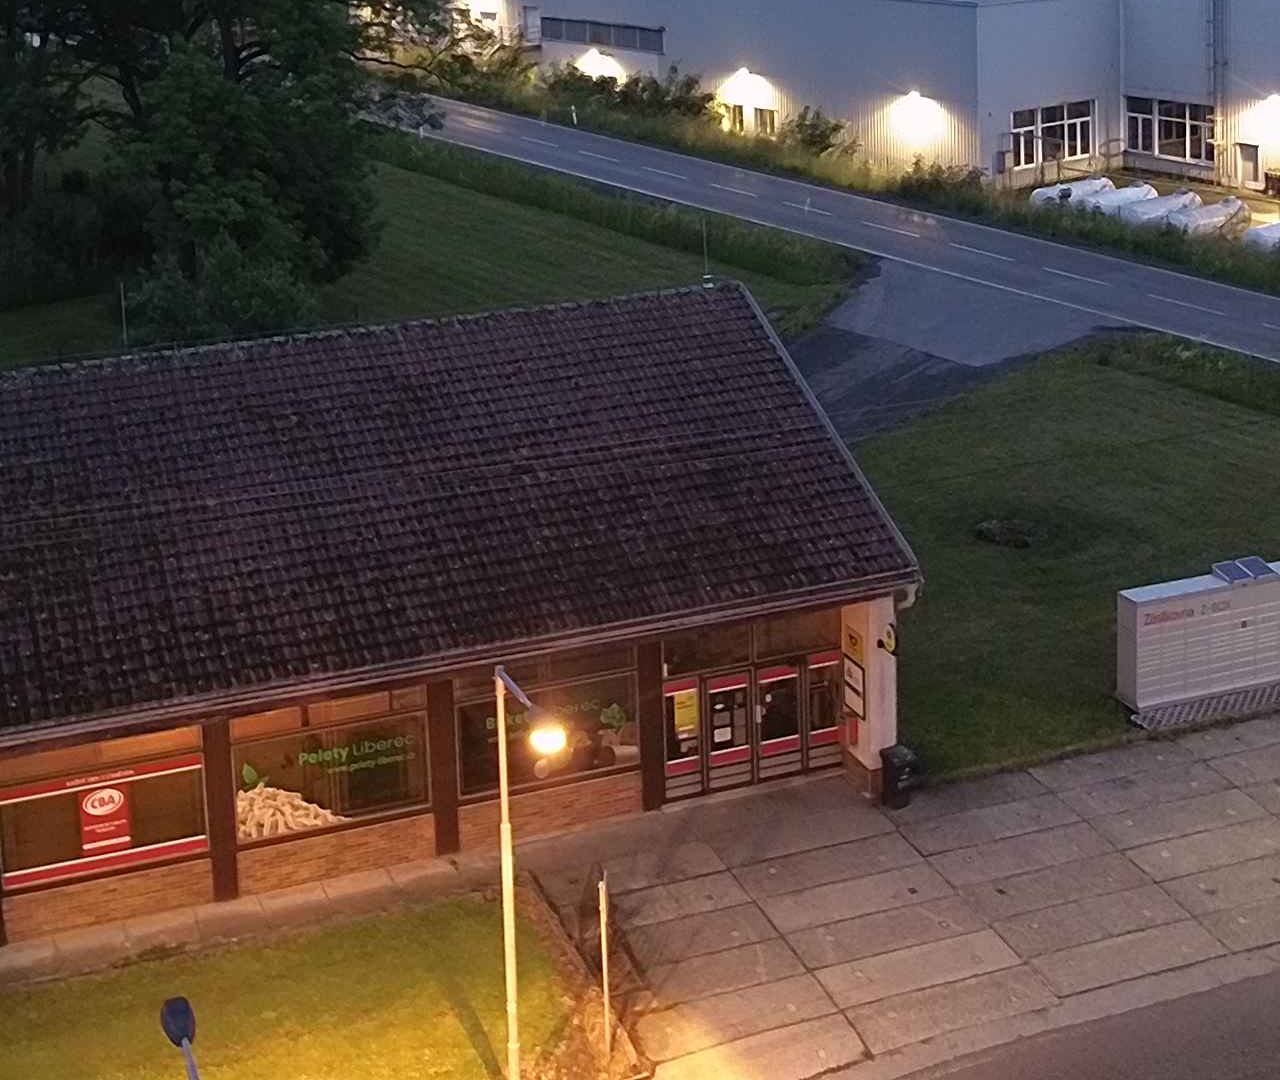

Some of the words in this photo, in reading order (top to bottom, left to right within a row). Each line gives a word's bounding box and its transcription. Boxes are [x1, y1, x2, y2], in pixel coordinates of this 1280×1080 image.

[298, 746, 350, 766] Pelety
[352, 734, 416, 756] Liberec
[90, 793, 116, 810] CBA
